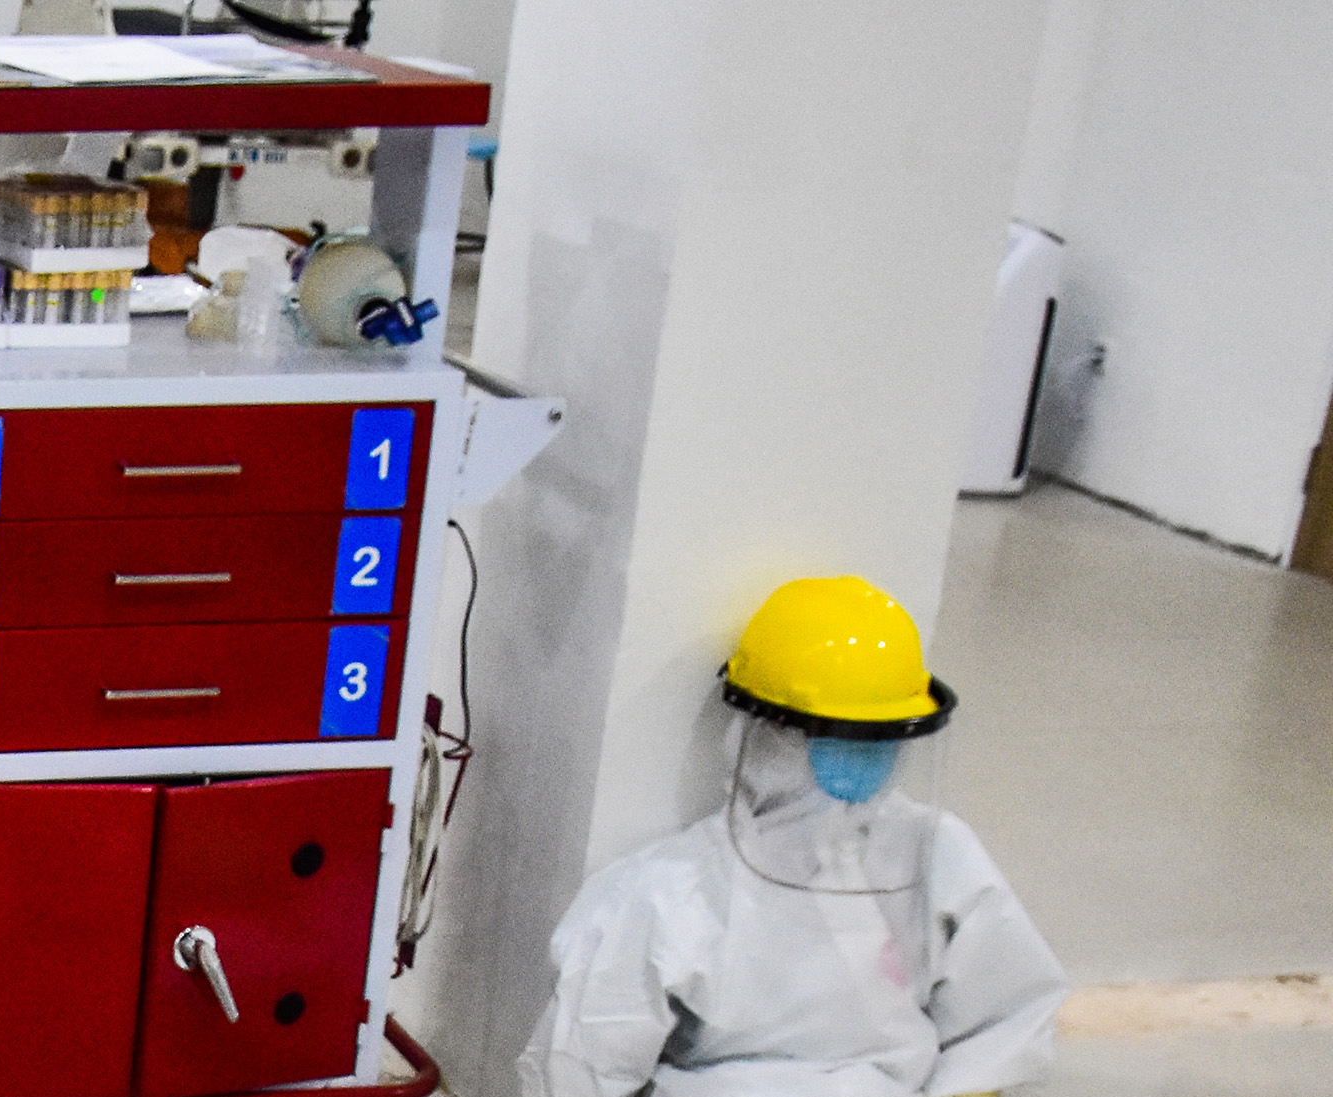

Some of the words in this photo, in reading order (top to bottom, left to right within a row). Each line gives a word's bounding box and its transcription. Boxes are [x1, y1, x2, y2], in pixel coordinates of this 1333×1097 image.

[369, 439, 391, 480] 1
[350, 546, 381, 587] 2
[338, 662, 368, 702] 3
